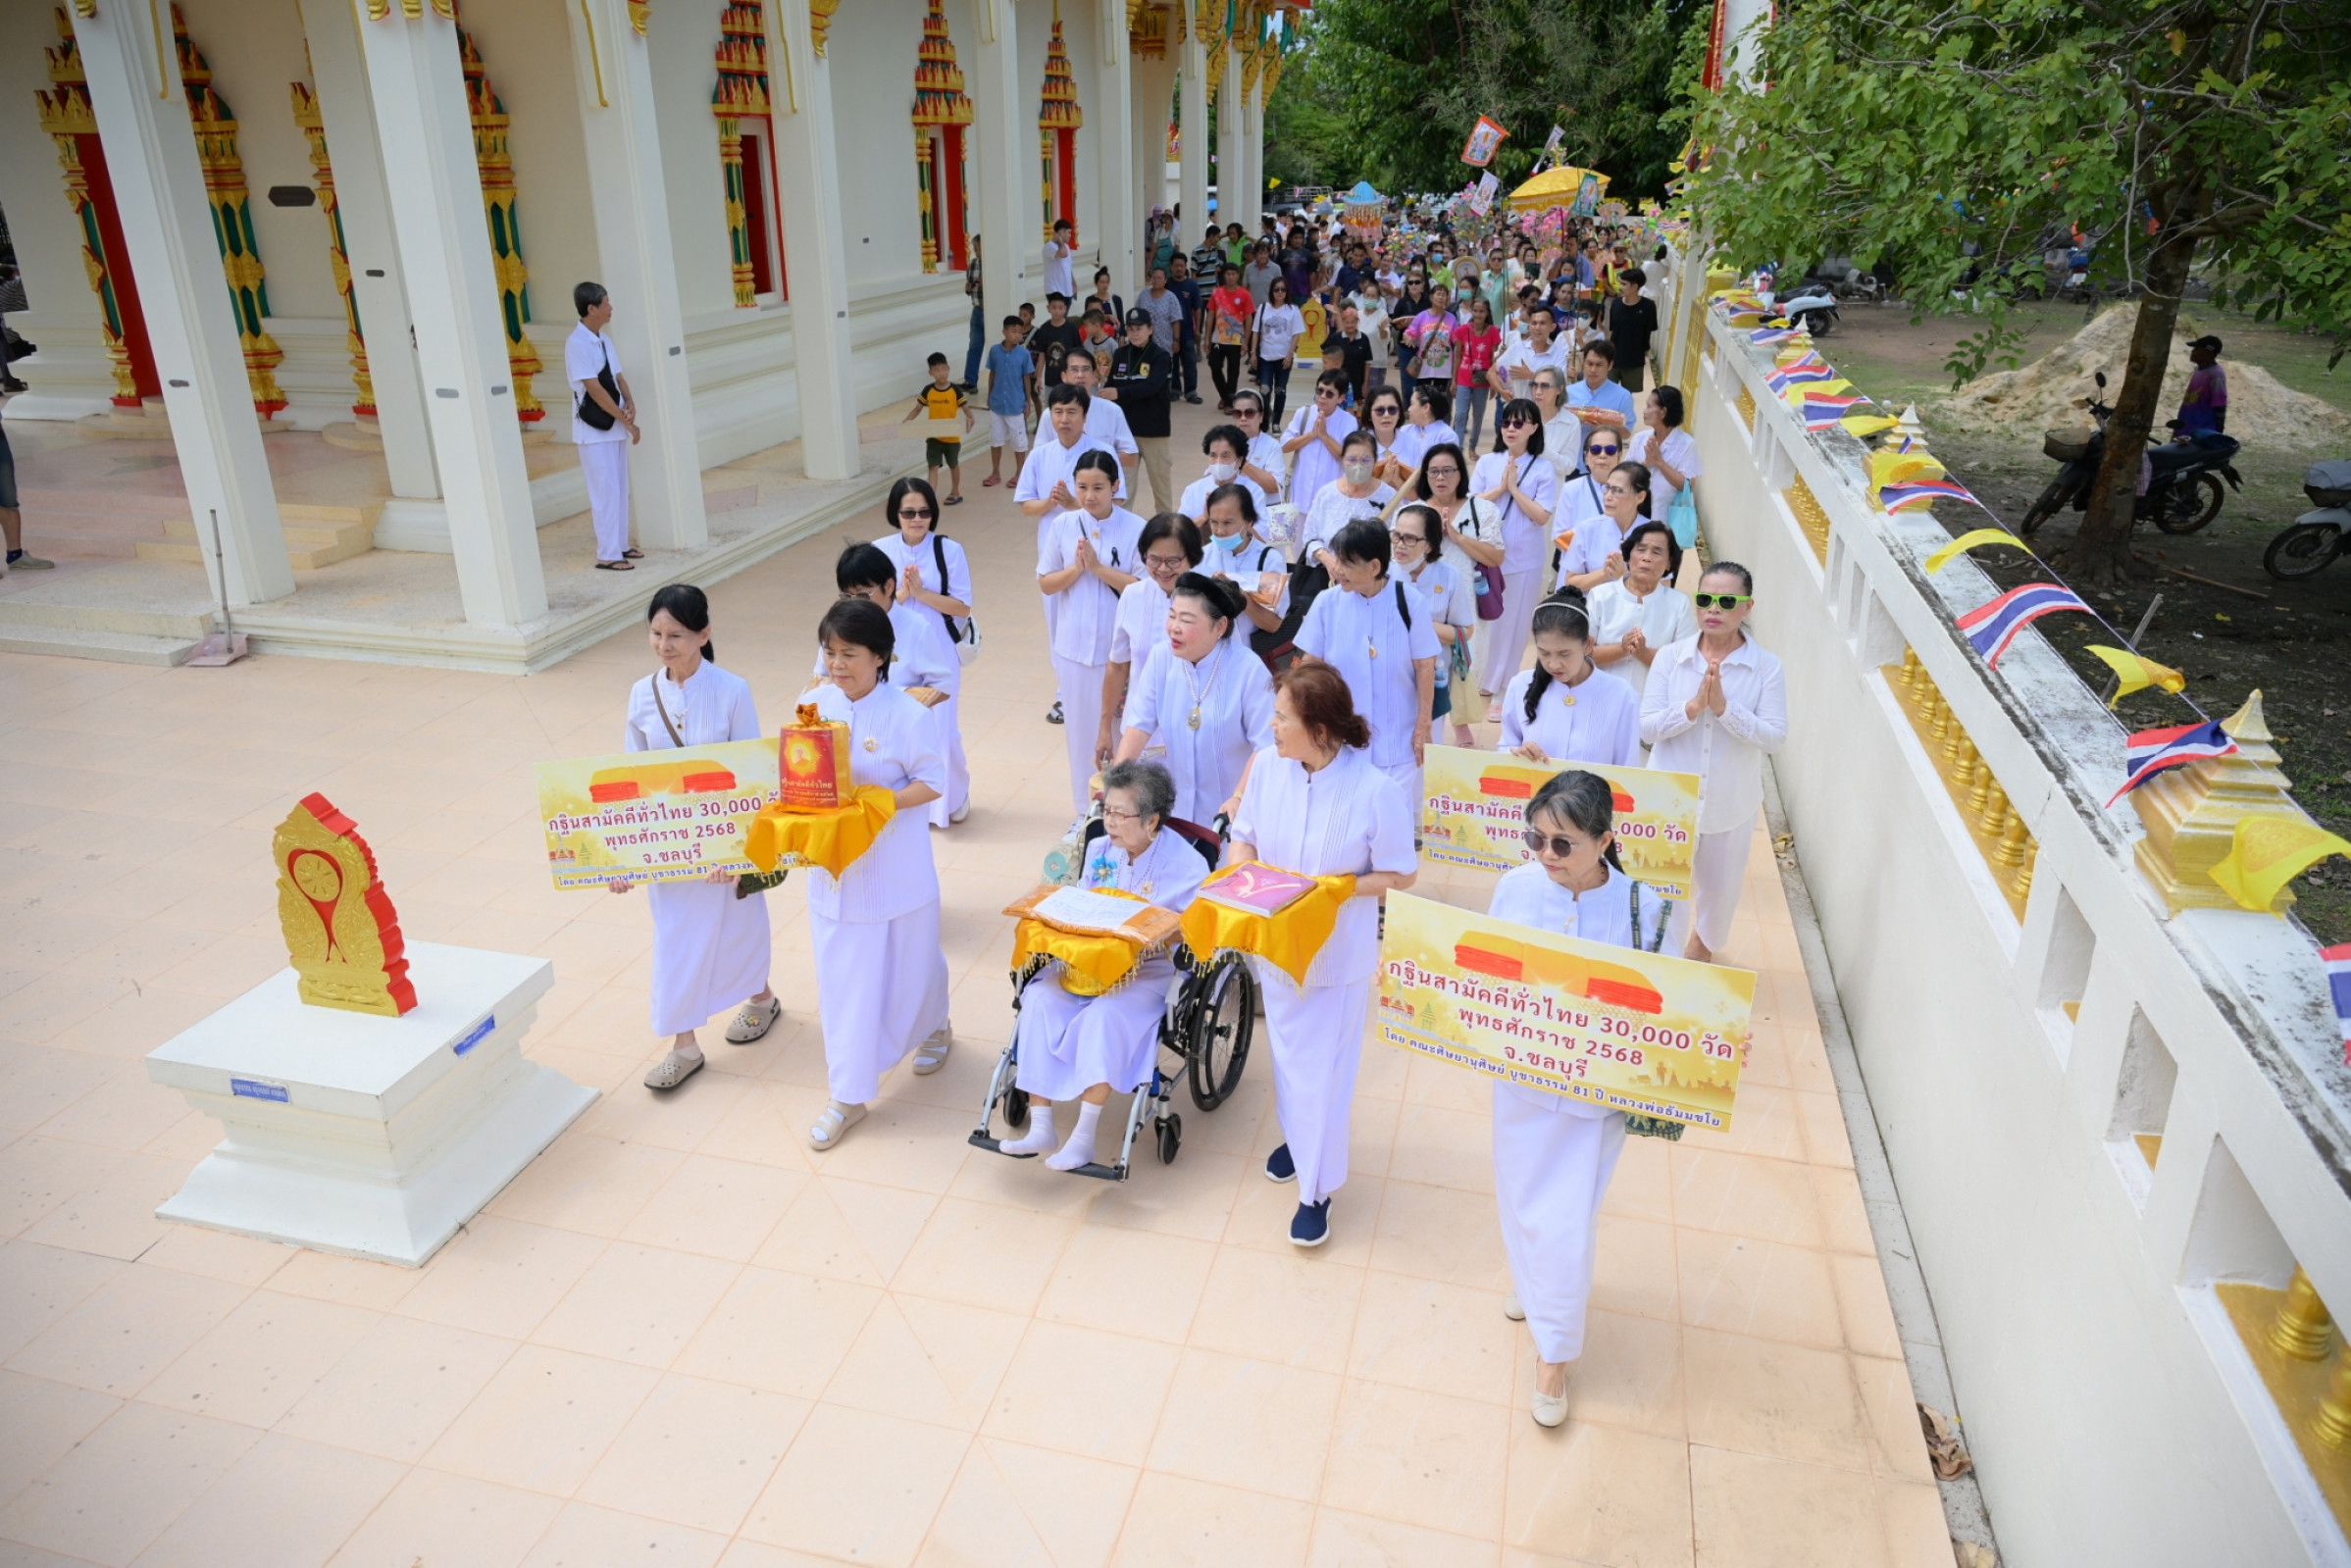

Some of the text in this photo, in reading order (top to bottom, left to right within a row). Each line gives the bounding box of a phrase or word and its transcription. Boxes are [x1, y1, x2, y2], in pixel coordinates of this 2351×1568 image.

[549, 797, 762, 835] กฐินสามัคคีทั่วไทย 30,000
[1429, 794, 1523, 821] กฐินสามัคคี
[1663, 824, 1687, 842] วัด
[604, 822, 736, 851] พุทธศักราช 2568
[642, 842, 702, 865] จ.ชลบุรี
[696, 865, 707, 874] 81
[1390, 960, 1732, 1059] กฐินสามัคคีทั่วไทย 30,000 วัด
[1458, 1006, 1644, 1066] พุทธศักราช 2568
[1385, 1027, 1720, 1127] โดย คณะศิษยานุศิษย์ บูชาธรรม 81 ปี หลวงพ่อธัมมชโย
[1505, 1044, 1589, 1082] จ.ชลบุรี
